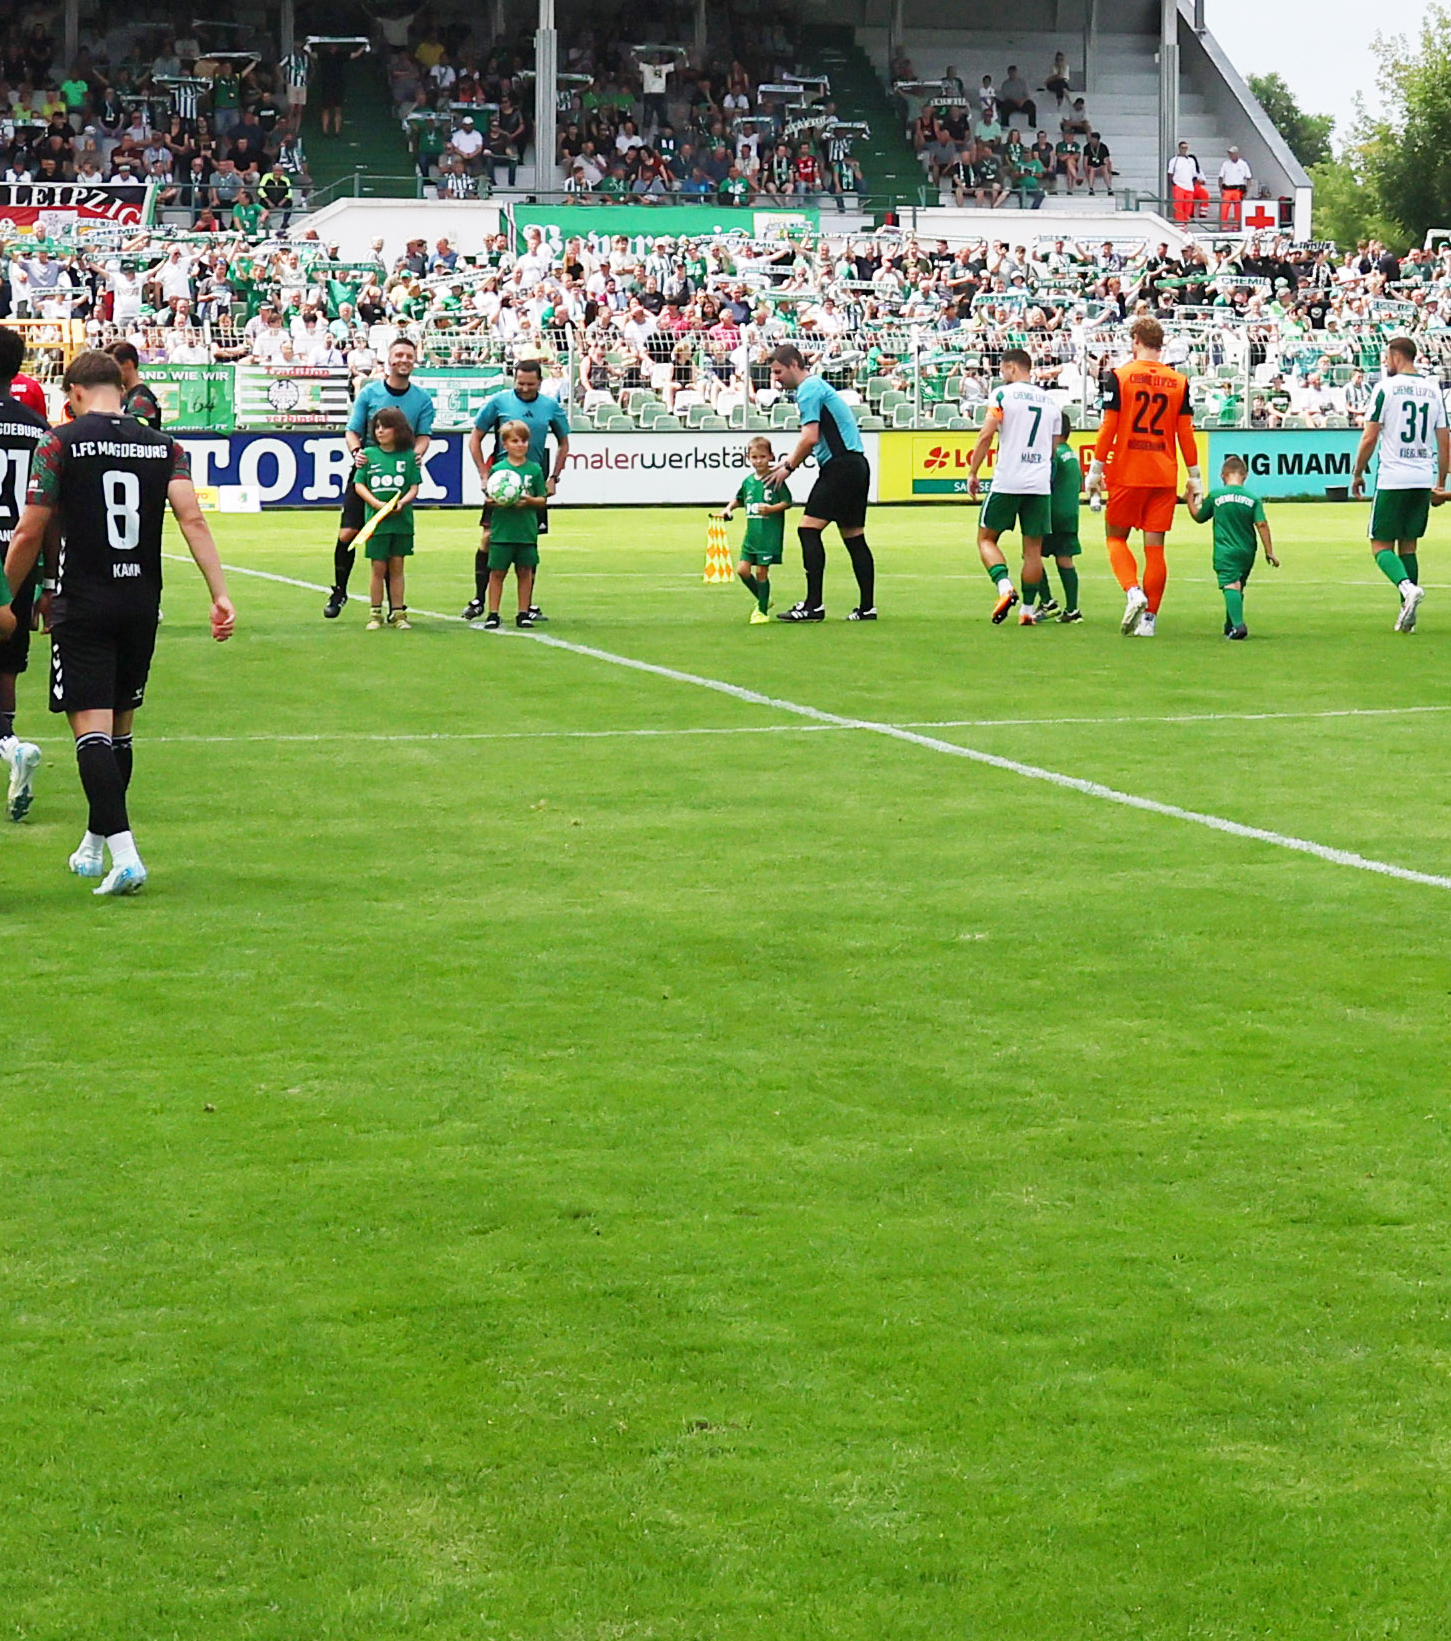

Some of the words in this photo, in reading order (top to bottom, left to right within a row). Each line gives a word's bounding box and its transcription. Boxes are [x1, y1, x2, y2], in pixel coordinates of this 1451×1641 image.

[8, 184, 142, 226] LEIPZIG
[171, 370, 199, 381] WIE
[202, 370, 230, 381] WIR
[264, 366, 331, 378] Tradition
[1027, 405, 1042, 448] 7
[1132, 390, 1169, 436] 22
[1400, 400, 1430, 444] 31
[71, 442, 96, 459] 1.FC
[97, 441, 169, 459] MAGDEBURG
[102, 469, 140, 550] 8
